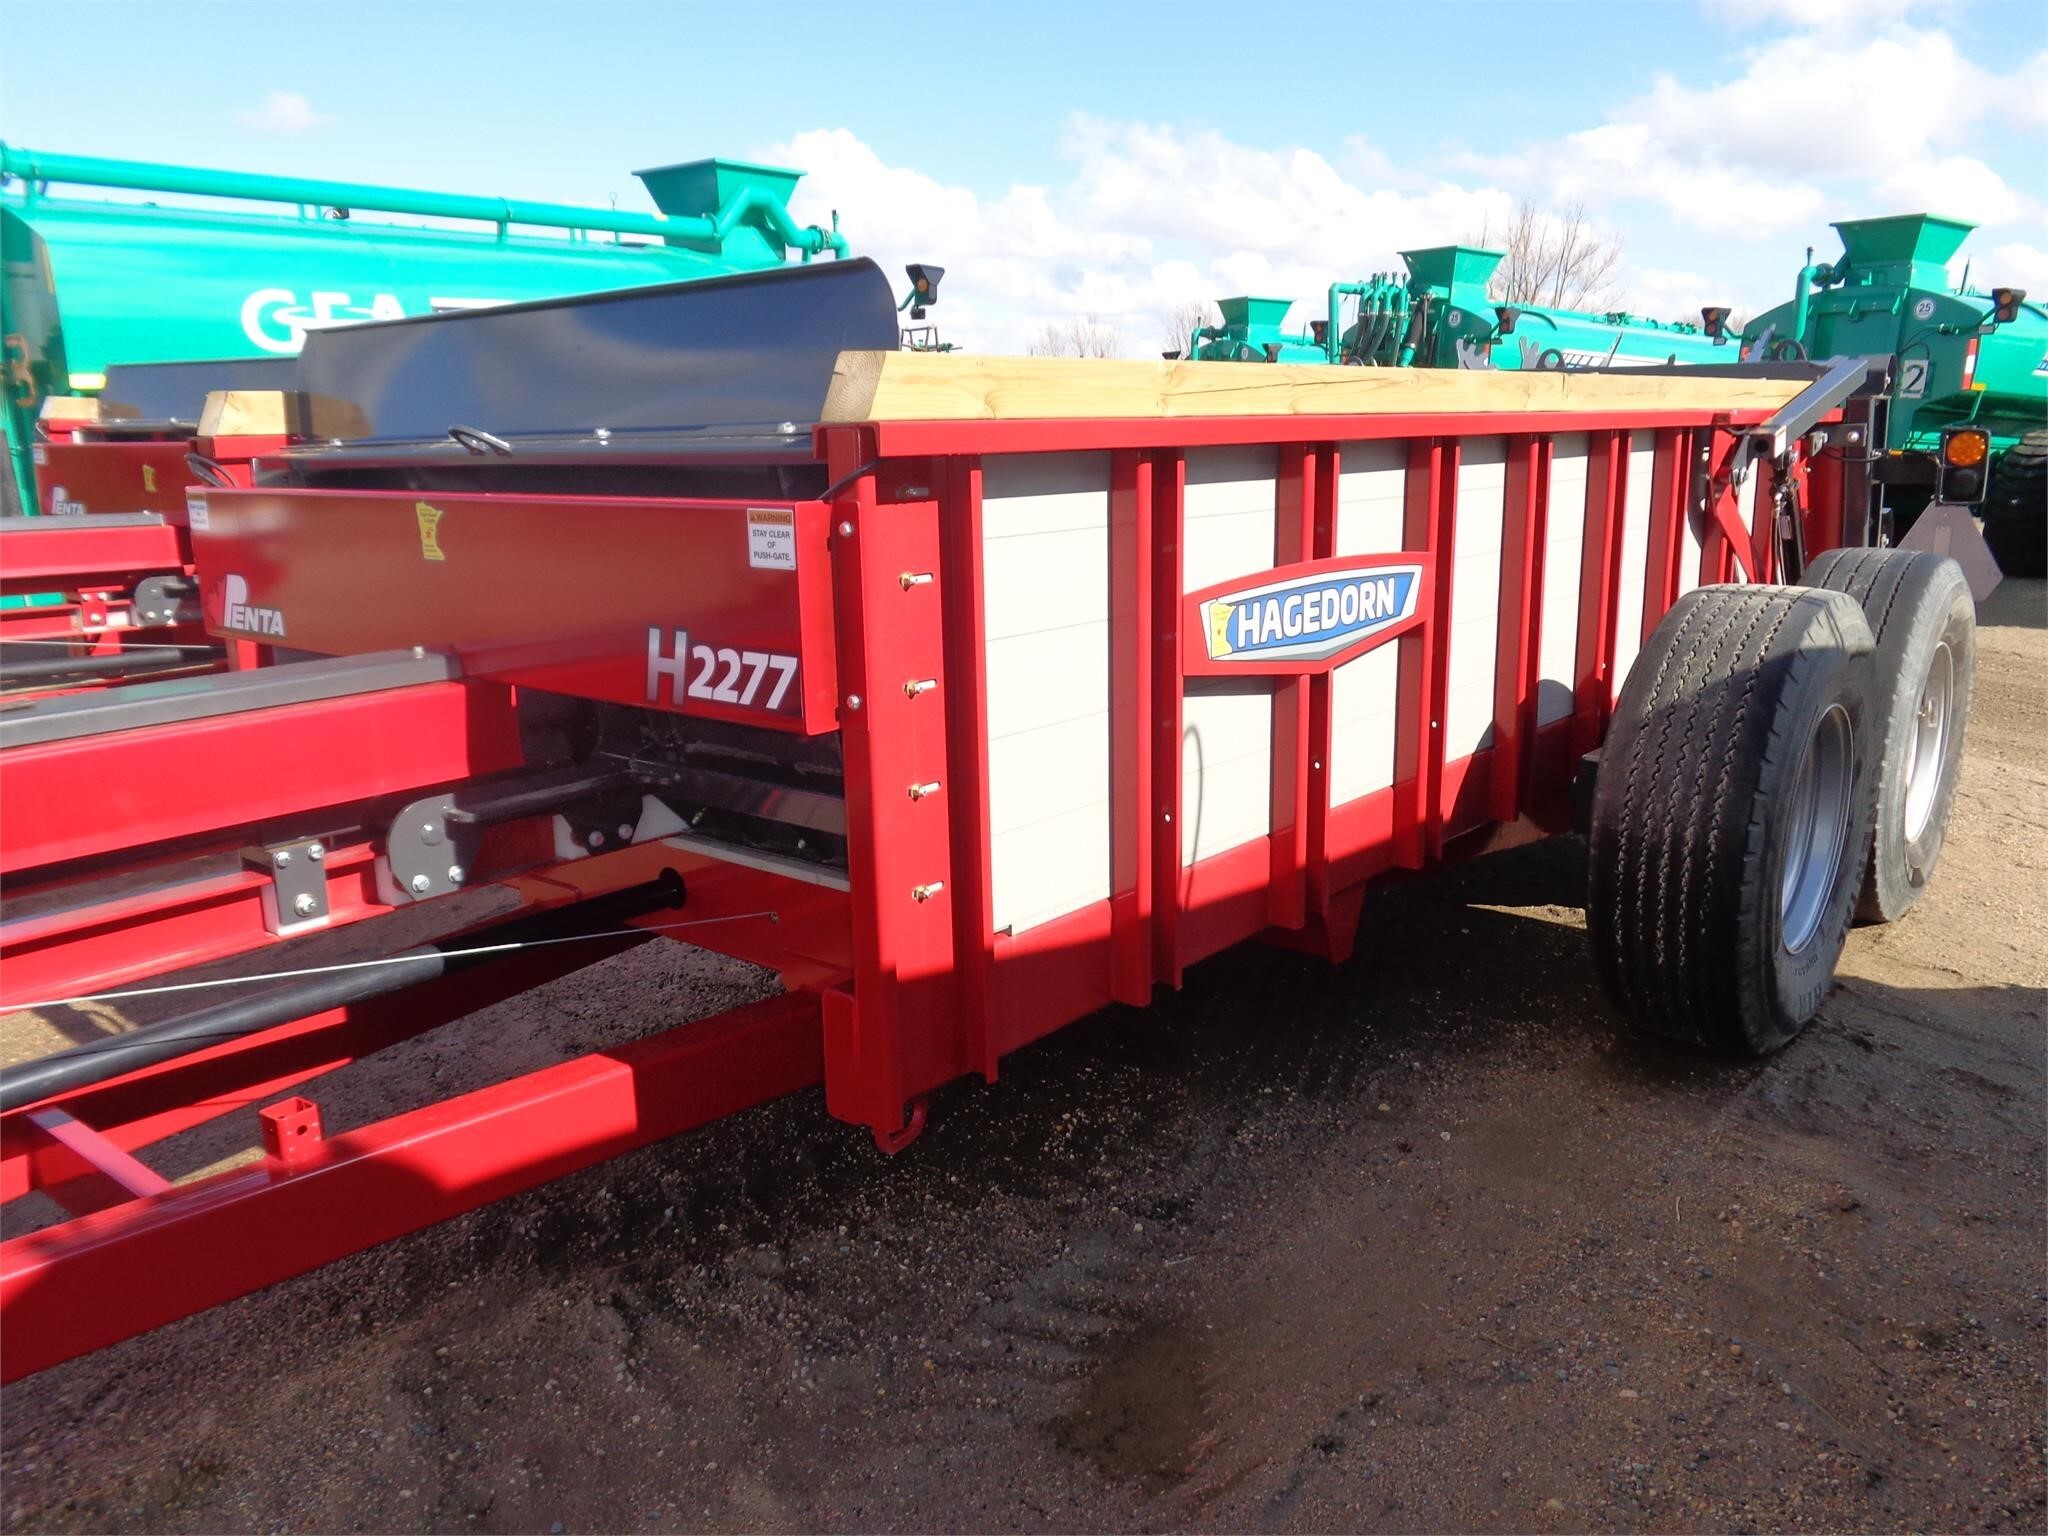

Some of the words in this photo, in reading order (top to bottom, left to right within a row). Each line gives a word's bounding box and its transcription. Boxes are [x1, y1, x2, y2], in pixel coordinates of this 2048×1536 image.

[1919, 303, 1931, 313] 25
[1903, 364, 1925, 394] 2
[756, 513, 791, 523] WARNING
[752, 529, 767, 537] STAY
[768, 530, 791, 539] CLEAR
[767, 541, 776, 549] OF
[223, 574, 285, 637] PENTA
[1237, 577, 1396, 649] HAGEDORN
